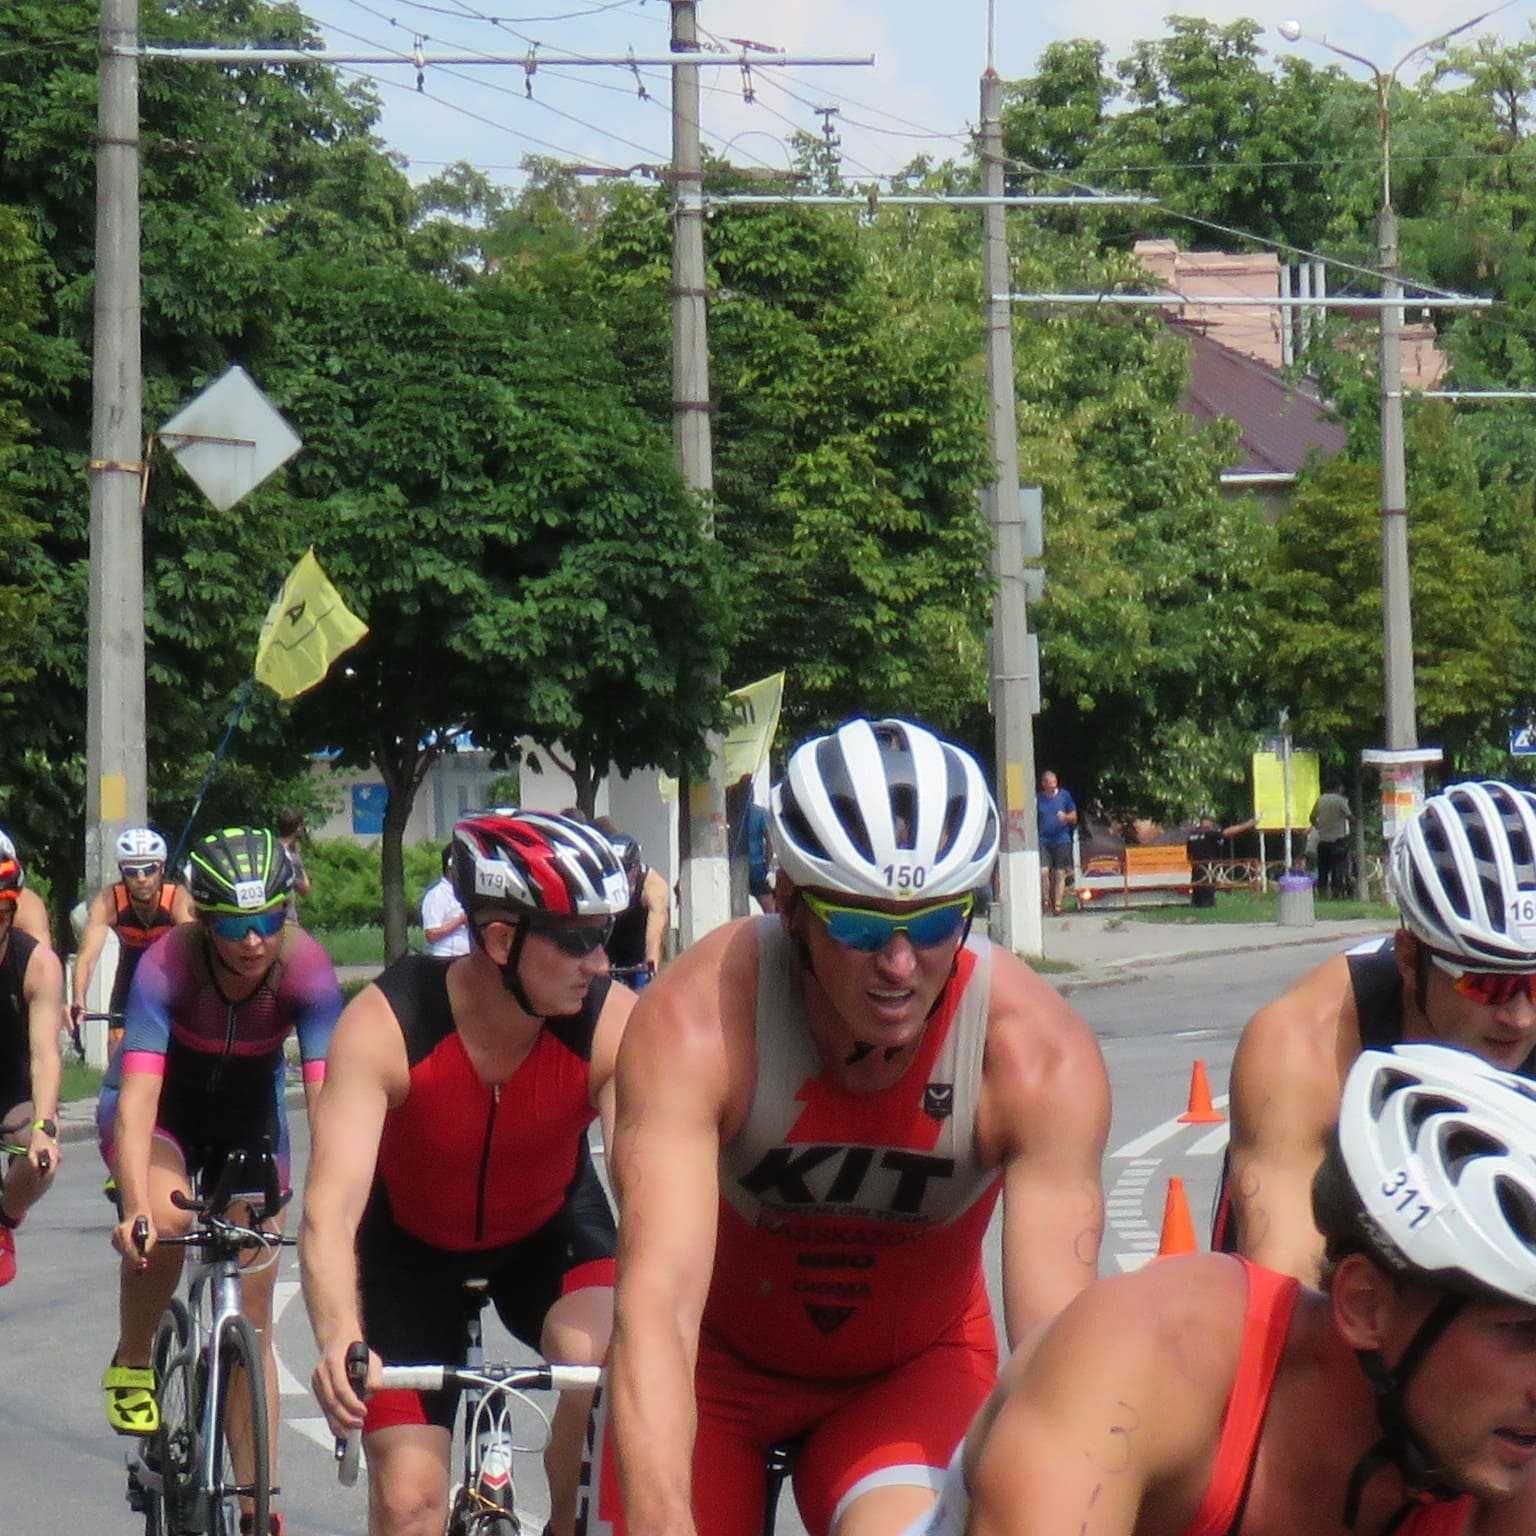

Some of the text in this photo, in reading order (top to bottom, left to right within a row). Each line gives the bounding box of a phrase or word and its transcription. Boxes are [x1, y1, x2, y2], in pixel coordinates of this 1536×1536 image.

[479, 871, 505, 889] 179
[883, 864, 926, 889] 150
[239, 886, 263, 900] 203
[736, 1146, 956, 1212] KIT
[1381, 1171, 1433, 1230] 311
